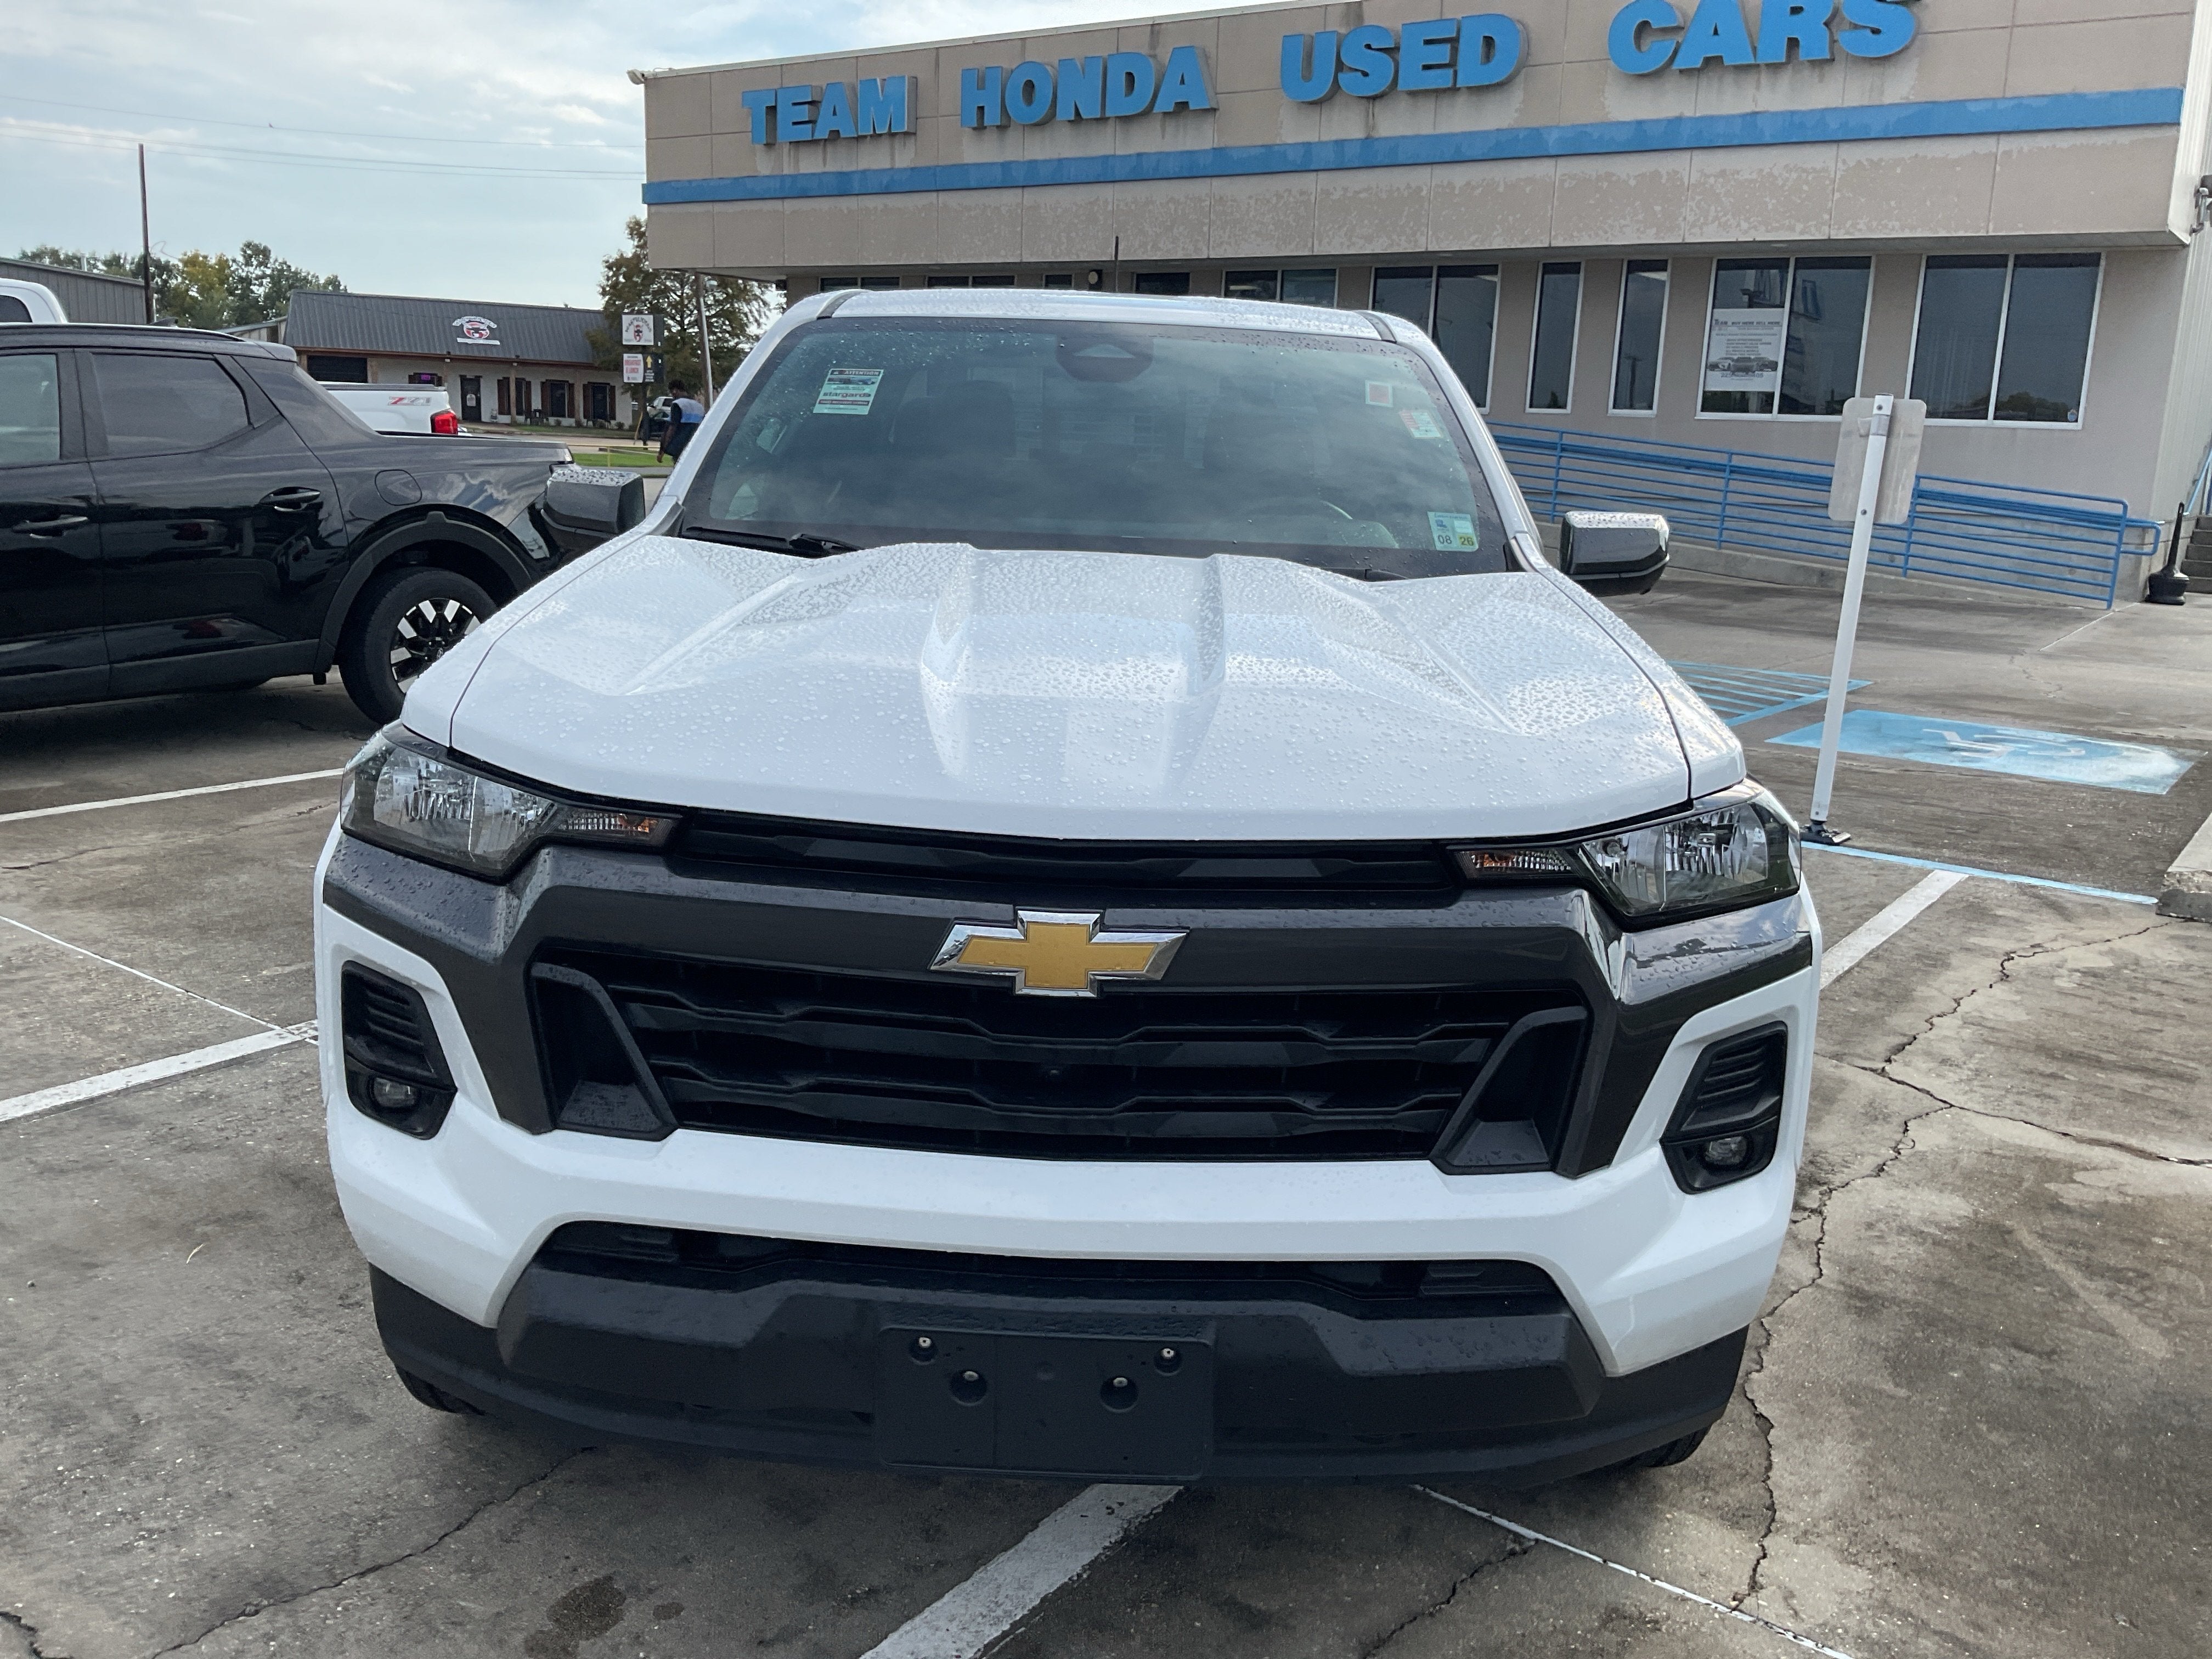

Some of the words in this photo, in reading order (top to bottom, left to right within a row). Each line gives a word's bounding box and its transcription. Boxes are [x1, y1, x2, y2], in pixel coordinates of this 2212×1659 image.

[742, 75, 909, 145] TEAM
[961, 46, 1211, 128] HONDA
[1280, 14, 1522, 101] USED
[1608, 0, 1916, 74] CARS
[388, 396, 431, 406] Z71
[1438, 535, 1452, 544] 08
[1460, 537, 1474, 546] 26
